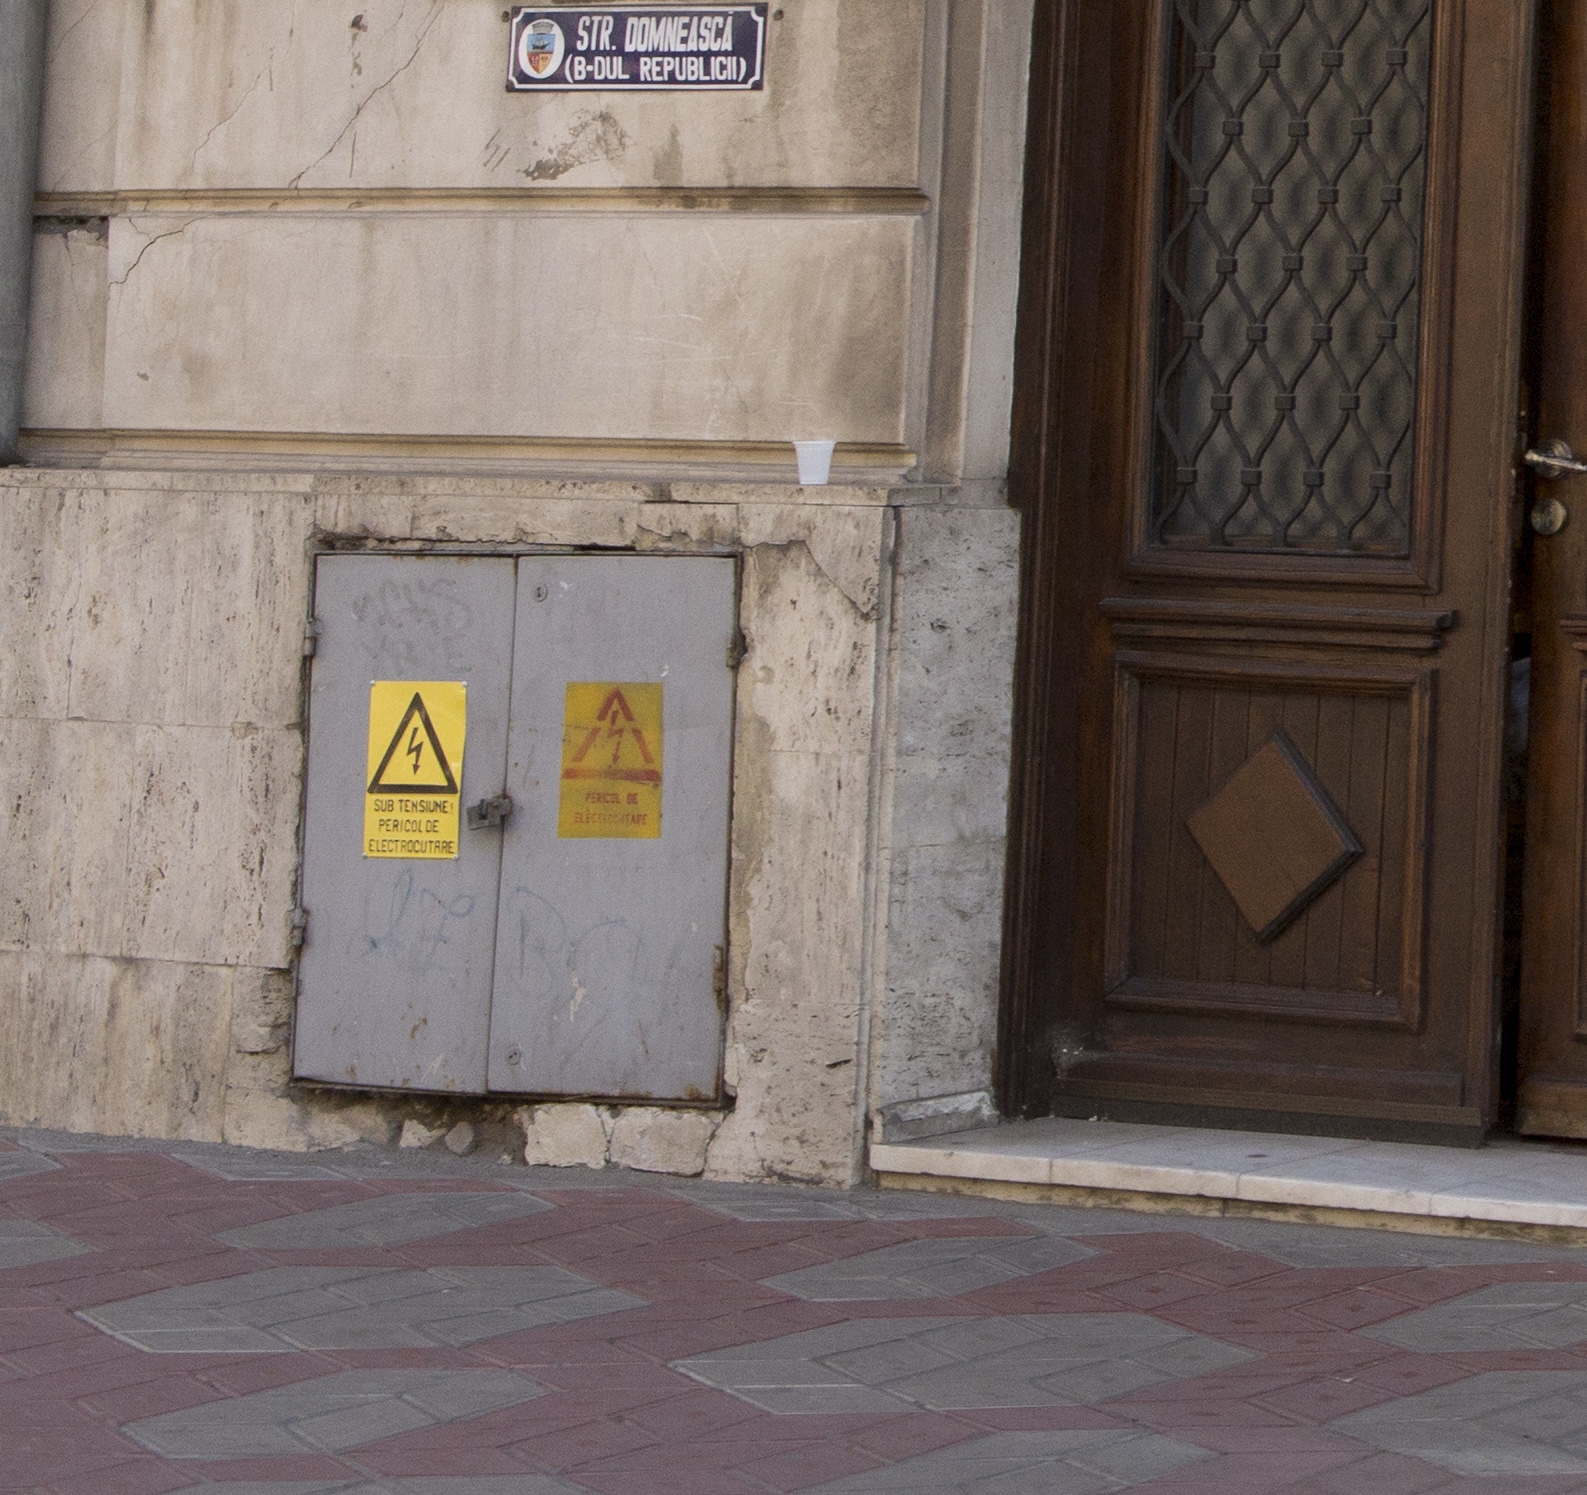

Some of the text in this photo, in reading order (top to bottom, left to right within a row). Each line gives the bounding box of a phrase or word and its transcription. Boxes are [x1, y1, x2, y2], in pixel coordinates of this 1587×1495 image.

[576, 15, 617, 52] STR.
[564, 54, 748, 84] (B-DUL REPUBLICII)
[373, 798, 395, 813] SUB
[378, 818, 439, 833] PERICOL DE
[368, 839, 454, 854] ELECTROCUTARE
